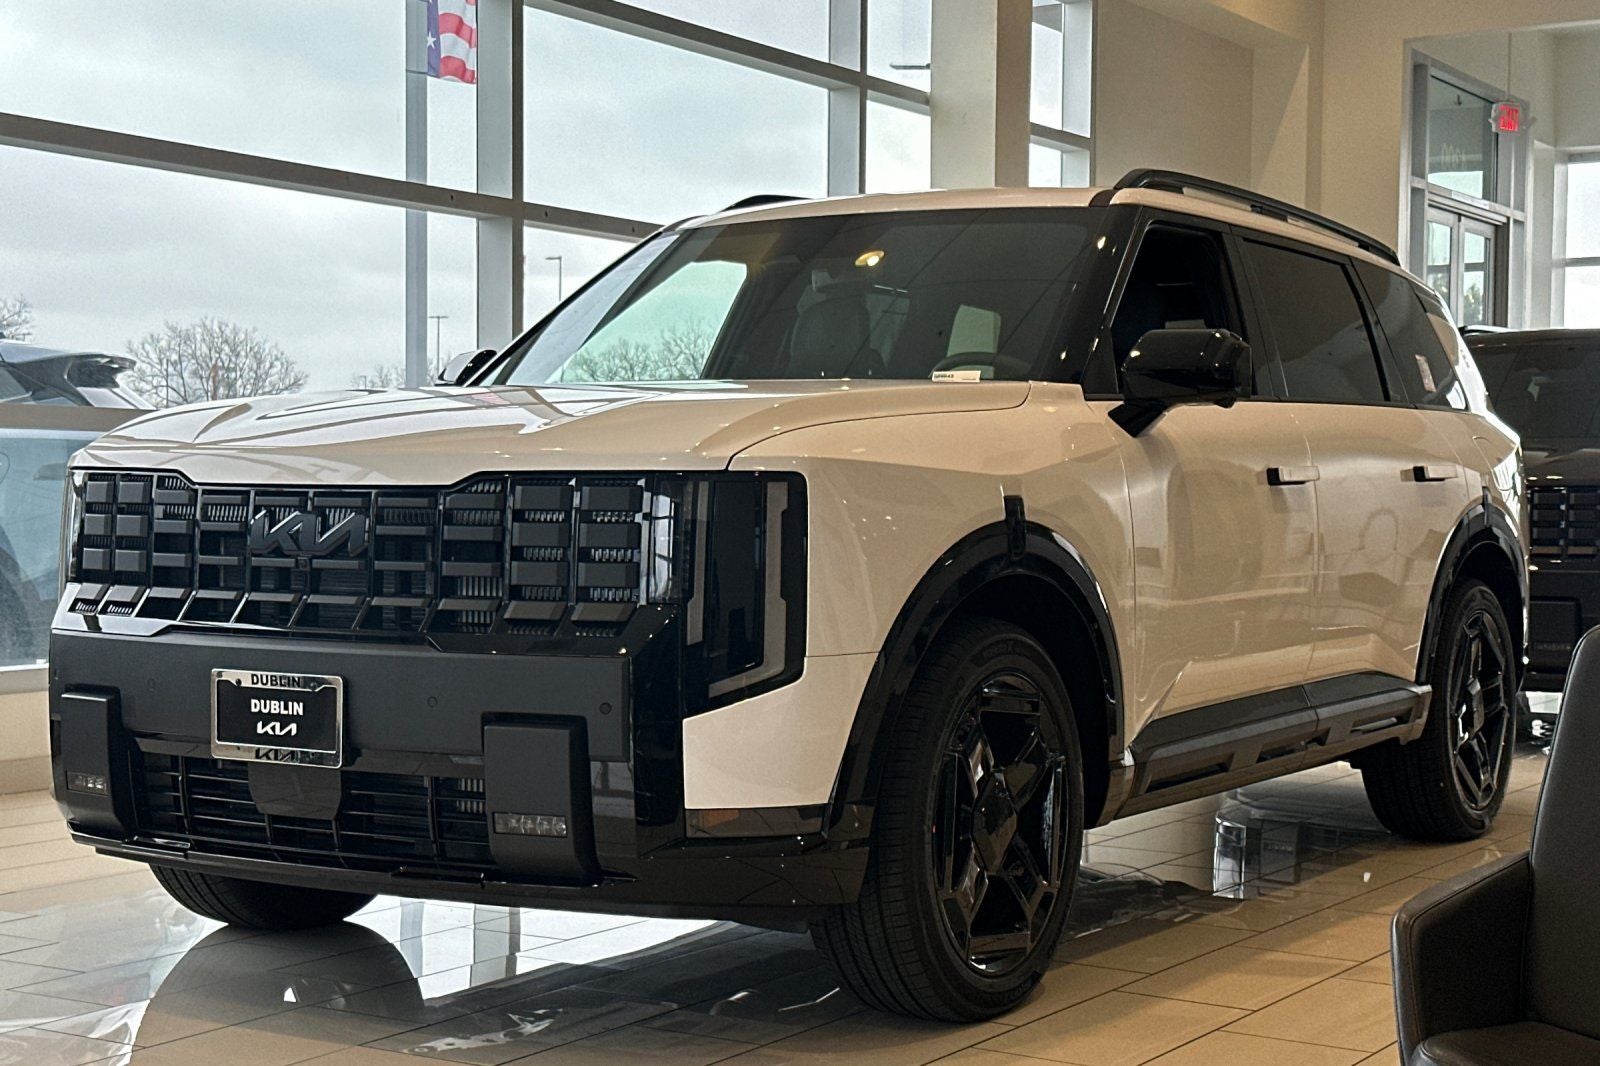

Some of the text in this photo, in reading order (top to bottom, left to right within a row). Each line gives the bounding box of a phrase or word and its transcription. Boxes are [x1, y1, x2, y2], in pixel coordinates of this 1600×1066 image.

[249, 508, 369, 557] KIA
[251, 673, 302, 688] DUBLIN
[250, 699, 303, 716] DUBLIN
[256, 720, 297, 736] KIA
